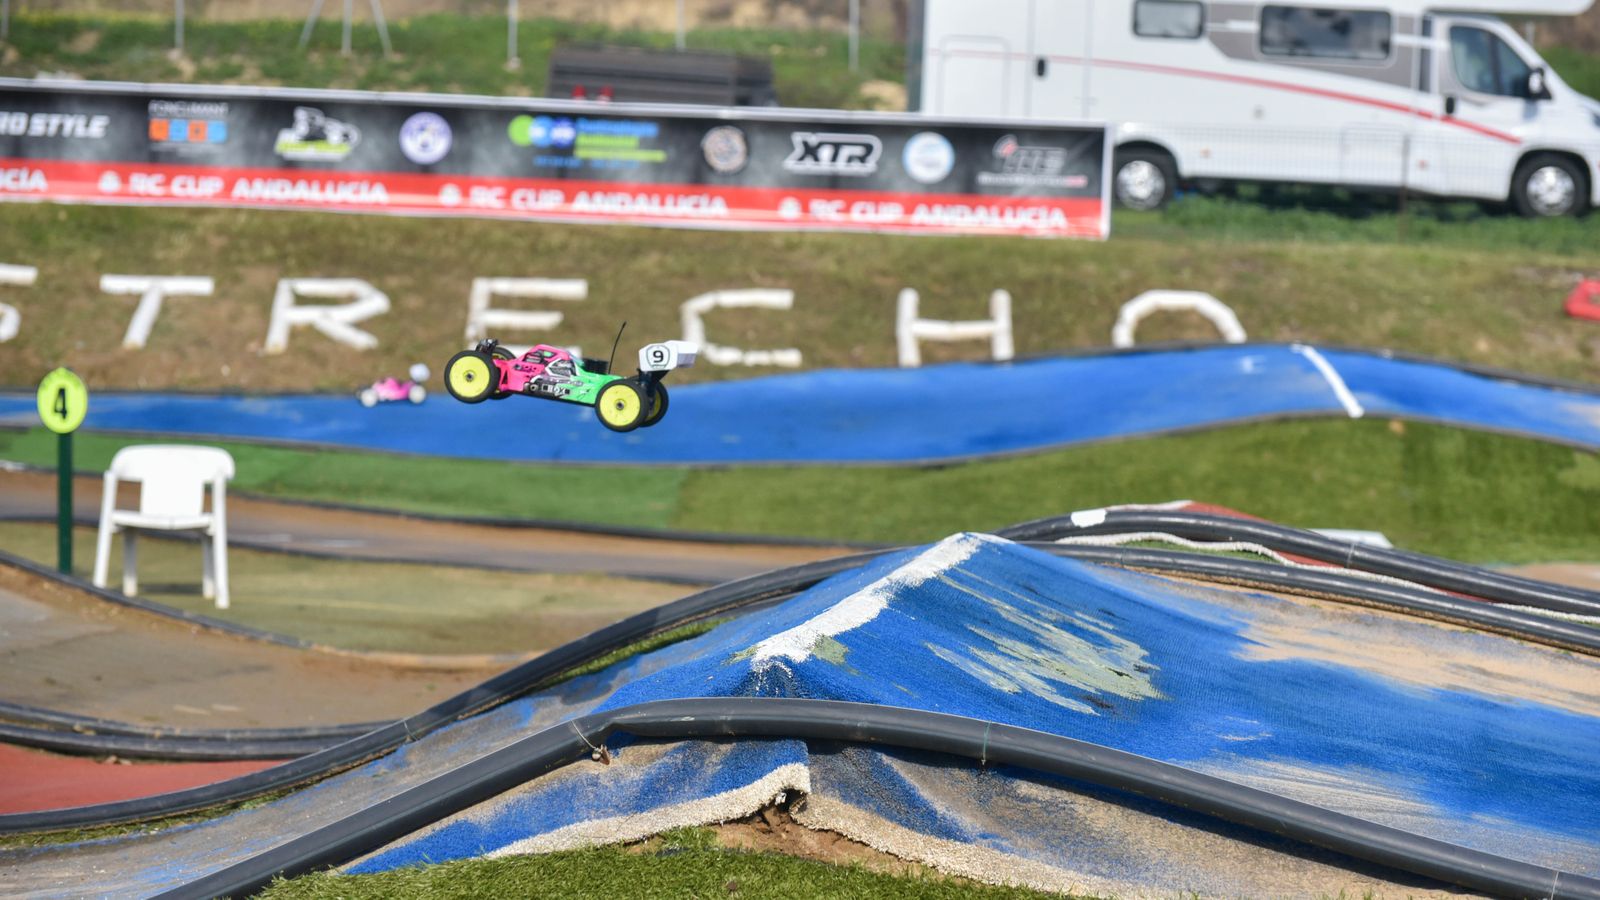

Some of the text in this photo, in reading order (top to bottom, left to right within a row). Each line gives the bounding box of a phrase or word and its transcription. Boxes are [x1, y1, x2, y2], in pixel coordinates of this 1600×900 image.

[28, 113, 110, 138] STYLE
[784, 132, 882, 176] XTR
[129, 173, 389, 205] RC CUP ANDALUCÍA
[469, 186, 728, 217] RC CUP ANDALUCÍA
[809, 198, 1068, 230] RC CUP ANDALUCÍA
[653, 350, 664, 363] 9
[54, 388, 68, 420] 4
